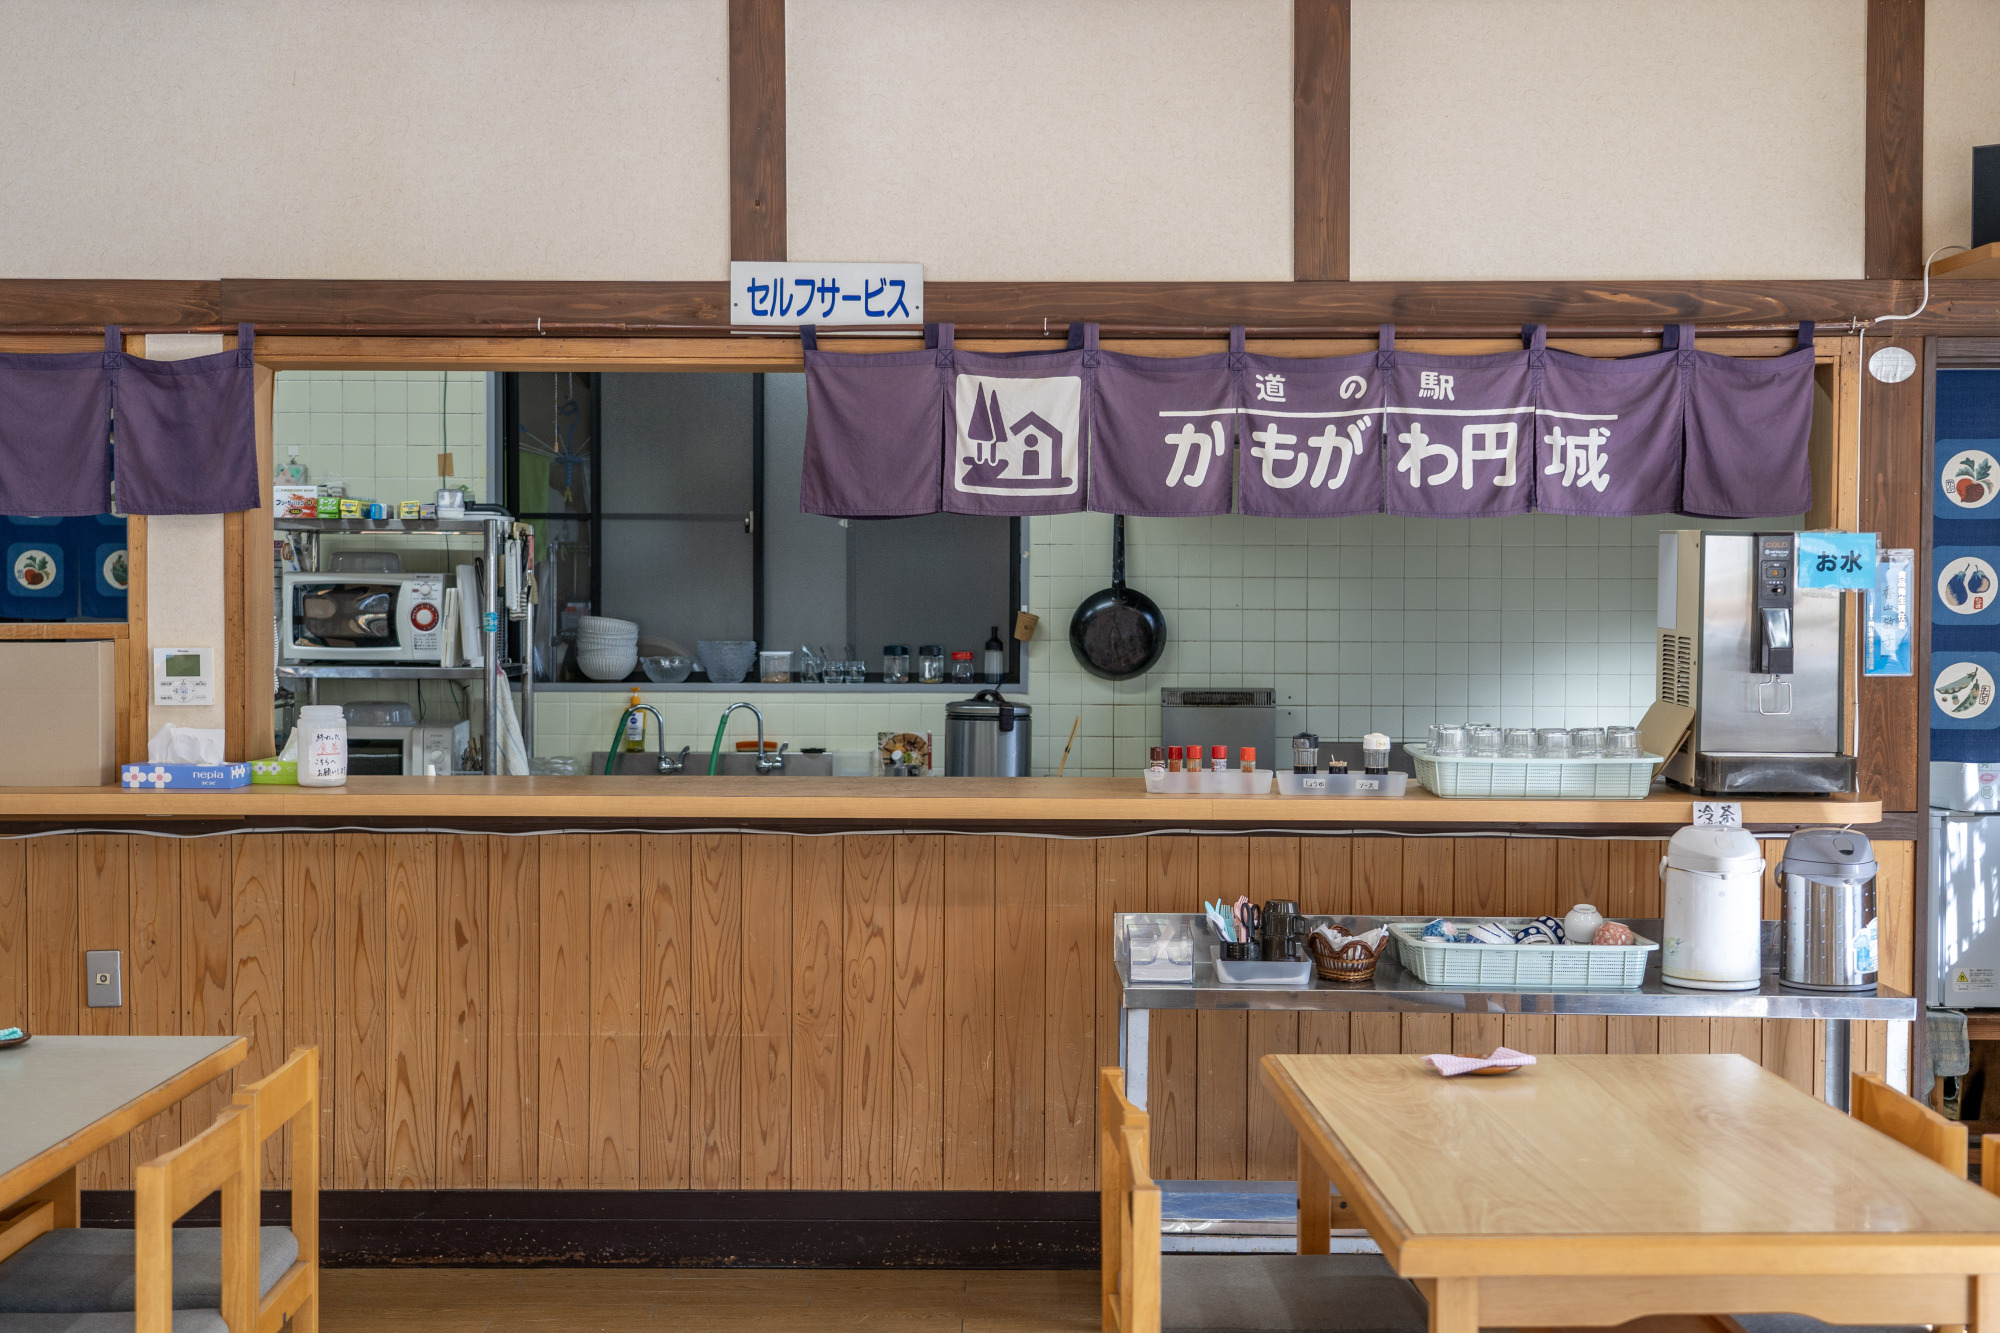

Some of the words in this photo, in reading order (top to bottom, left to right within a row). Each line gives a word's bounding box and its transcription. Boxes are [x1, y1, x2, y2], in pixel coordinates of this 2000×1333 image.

[747, 277, 909, 318] セルフサービス
[1164, 415, 1613, 492] かもがわ円城
[1816, 550, 1863, 573] お水
[193, 770, 224, 779] nepia
[1305, 779, 1325, 788] しょうゆ
[1697, 804, 1736, 823] 冷茶
